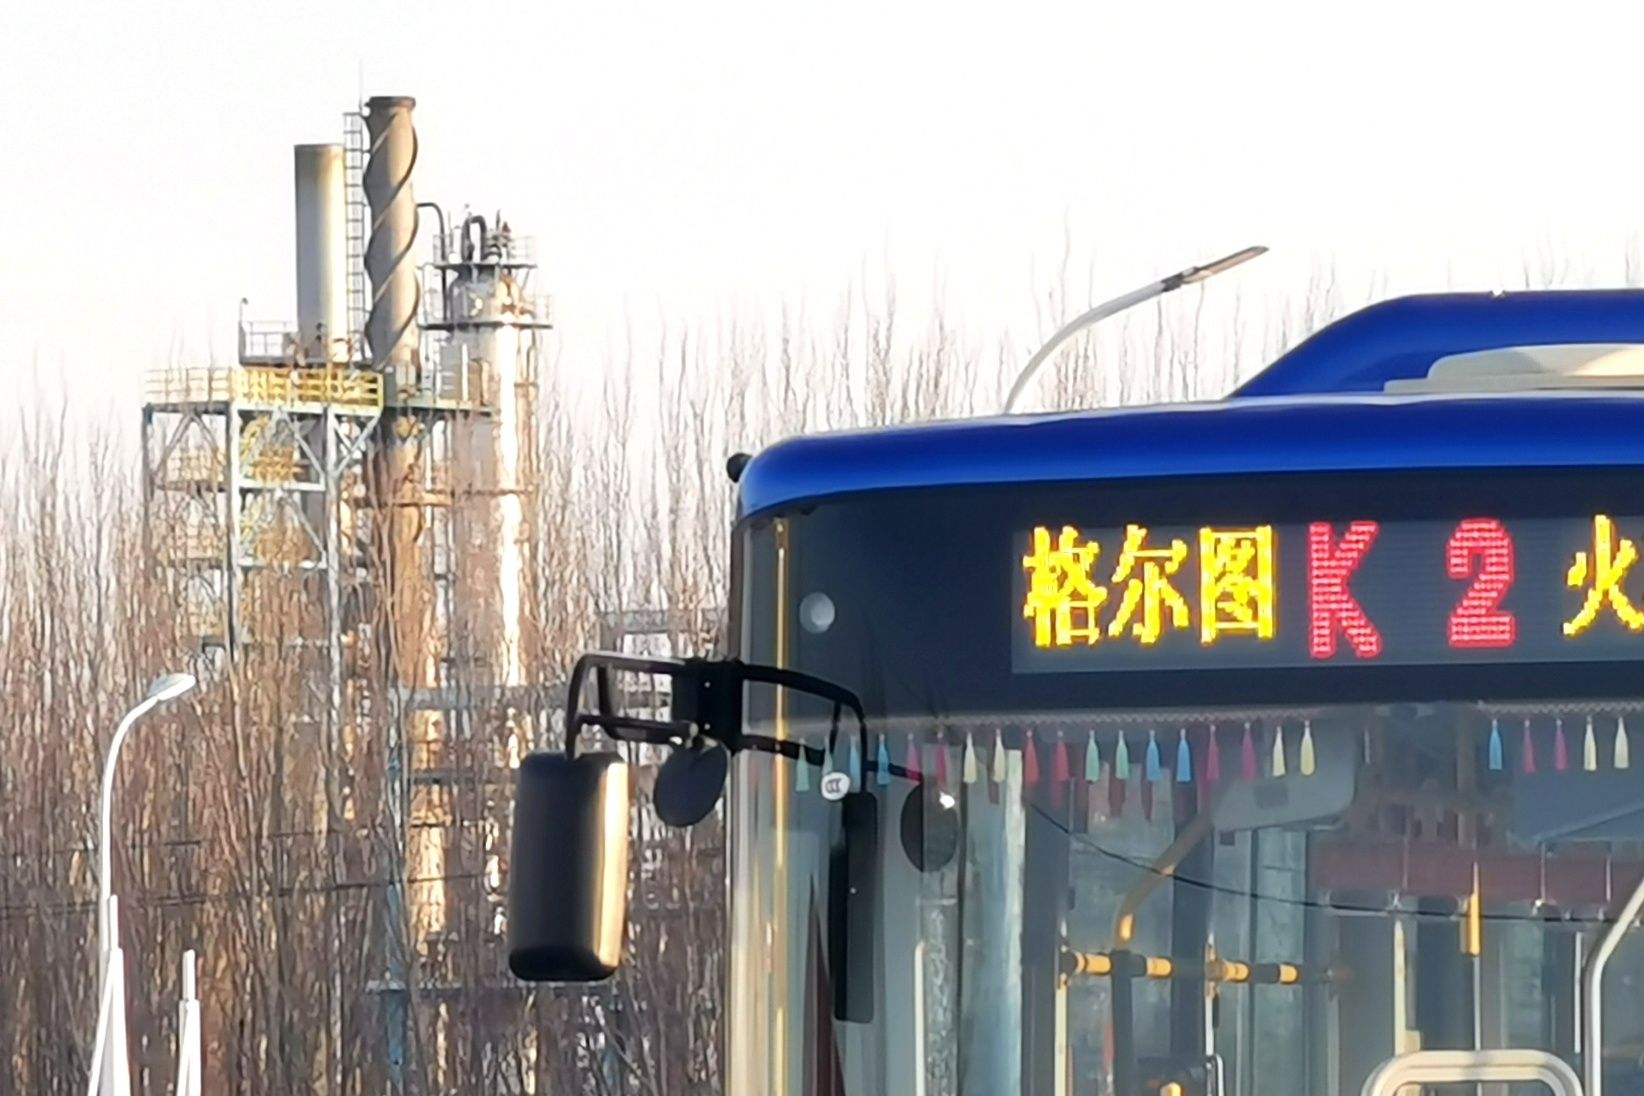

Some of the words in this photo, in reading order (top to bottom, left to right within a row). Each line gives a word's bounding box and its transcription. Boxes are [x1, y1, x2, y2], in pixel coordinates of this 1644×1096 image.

[1022, 523, 1278, 649] 格尔图
[1307, 520, 1382, 659] K
[1445, 517, 1517, 648] 2
